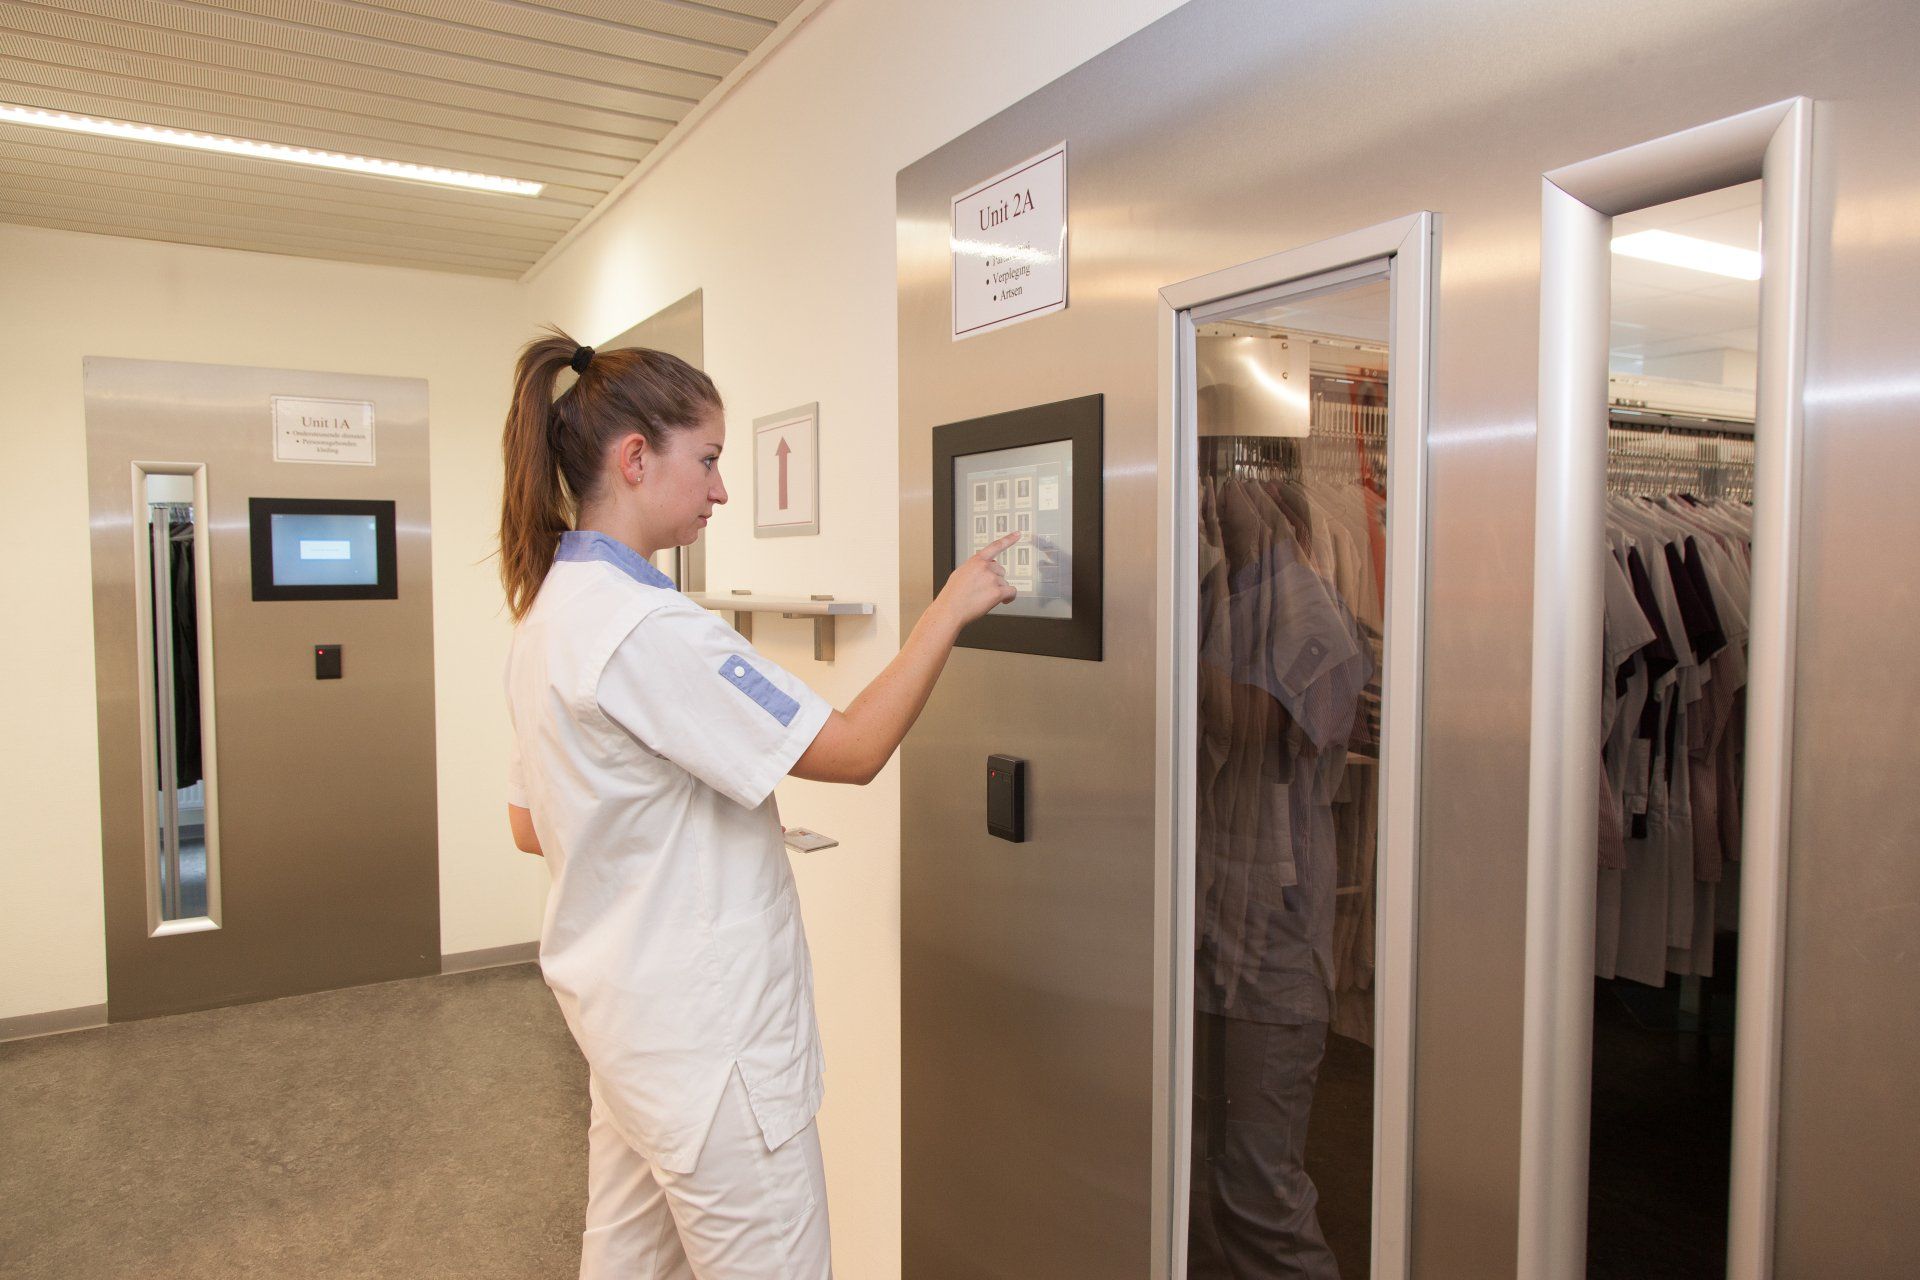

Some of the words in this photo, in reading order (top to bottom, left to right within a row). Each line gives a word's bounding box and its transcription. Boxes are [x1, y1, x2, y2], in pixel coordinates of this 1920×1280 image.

[980, 199, 1009, 231] Unit
[1013, 188, 1034, 217] 2A
[993, 264, 1031, 284] Verpleging
[1000, 286, 1023, 301] Artsen
[302, 416, 329, 428] Unit
[334, 418, 350, 429] 1A
